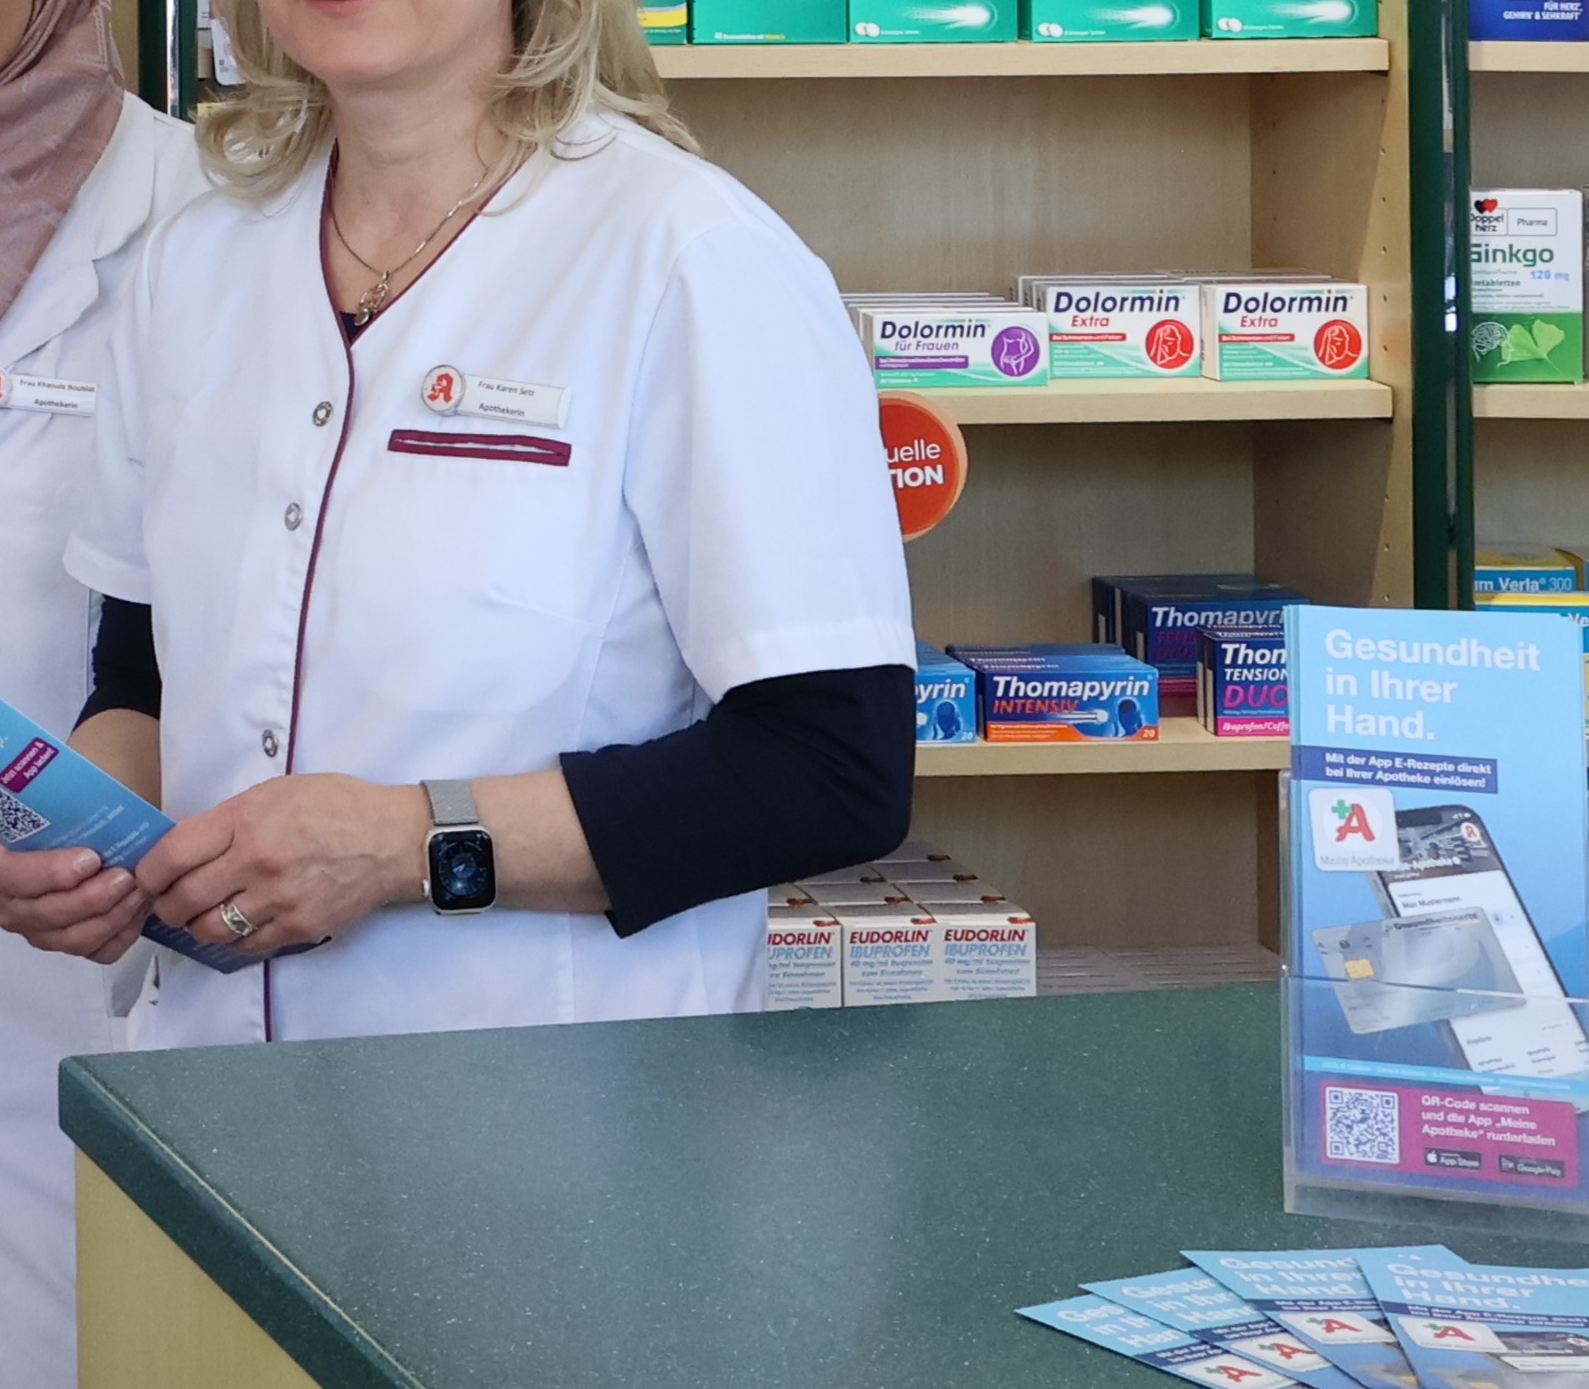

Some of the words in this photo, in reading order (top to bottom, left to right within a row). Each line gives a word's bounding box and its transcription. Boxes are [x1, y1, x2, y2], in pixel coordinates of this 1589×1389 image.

[1053, 289, 1180, 313] Dolormin
[1222, 289, 1349, 313] Dolormin
[881, 319, 986, 339] Dolormin
[1071, 315, 1109, 328] Extra
[1240, 315, 1278, 328] Extra
[895, 340, 912, 351] für
[915, 340, 959, 351] Frauen
[1549, 577, 1572, 590] 300
[1325, 629, 1540, 670] Gesundheit
[993, 676, 1150, 701] Thomapyrin
[1325, 668, 1358, 696] in
[1371, 670, 1458, 703] Ihrer
[993, 698, 1079, 714] INTENSIV
[1326, 705, 1436, 740] Hand.
[1325, 753, 1345, 764] Mit
[1347, 754, 1366, 766] der
[1368, 756, 1392, 769] App
[1395, 758, 1455, 774] E-Rezepte
[1457, 763, 1492, 775] direkt
[1325, 766, 1344, 777] bei
[1346, 768, 1374, 780] Ihrer
[1376, 772, 1431, 785] Apotheke
[1433, 775, 1486, 788] einlösen!
[850, 931, 928, 944] EUDORLIN
[944, 929, 1026, 942] EUDORLIN
[850, 945, 930, 958] IBUPROFEN
[944, 944, 1027, 956] IBUPROFEN
[1421, 1095, 1477, 1110] QR-Code
[1468, 1115, 1492, 1128] App
[1486, 1132, 1556, 1146] runterladen
[1443, 1279, 1534, 1298] Ihrer
